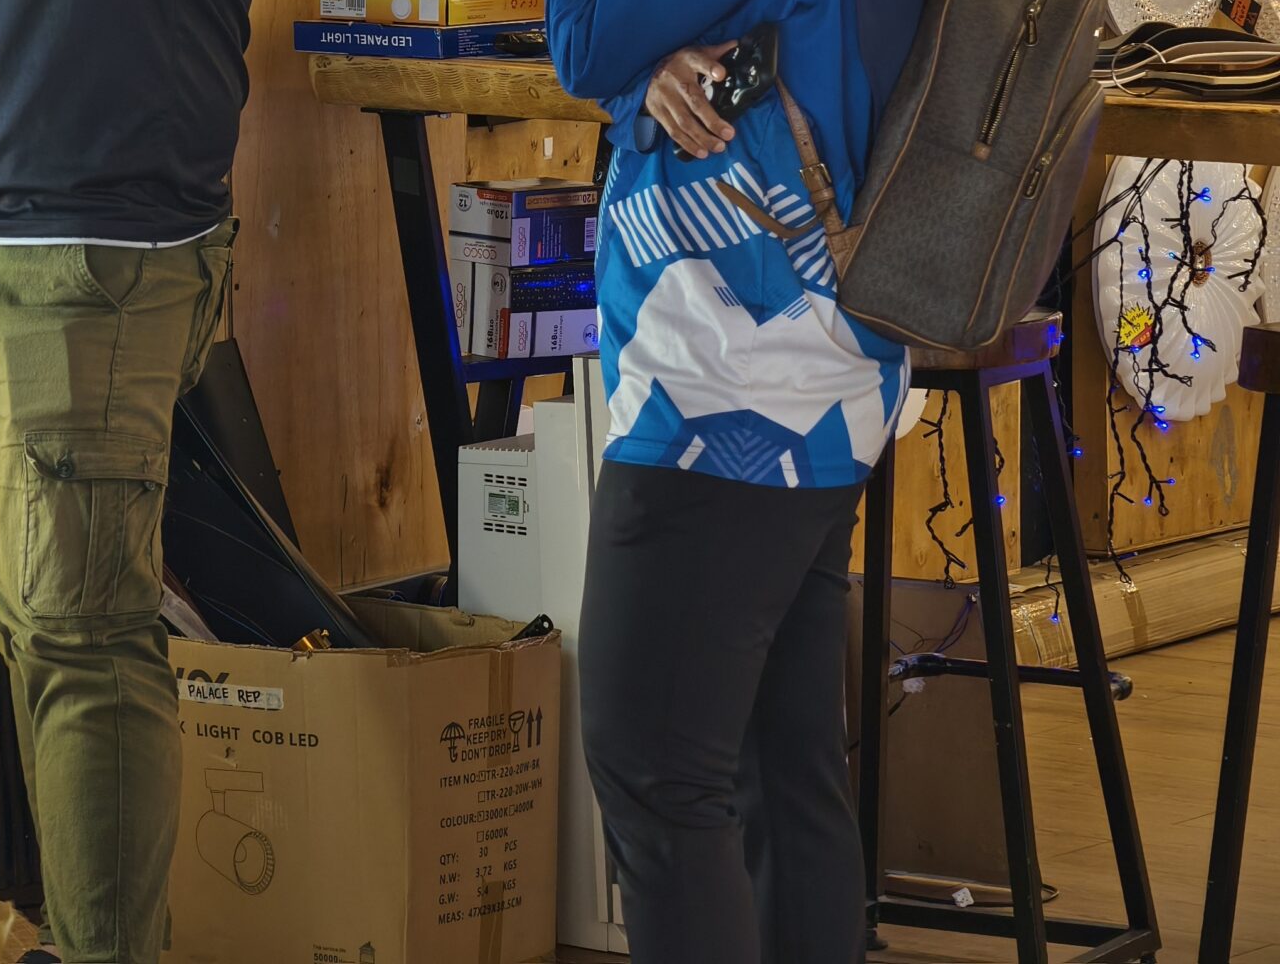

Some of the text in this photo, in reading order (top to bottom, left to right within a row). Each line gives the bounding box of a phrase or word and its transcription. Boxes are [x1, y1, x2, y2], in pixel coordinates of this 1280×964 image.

[320, 31, 412, 47] LED PANEL LIGHT
[188, 685, 262, 704] PALACE REP
[468, 714, 506, 730] FRAGILE
[196, 723, 241, 741] LIGHT
[252, 729, 285, 745] COB
[289, 732, 319, 748] LED
[466, 728, 507, 746] KEEP DRY
[461, 742, 512, 762] DON'T DROP
[440, 776, 461, 788] ITEM
[440, 800, 534, 828] COLOUR: 3000K 4000K
[485, 827, 509, 841] 6000K
[440, 840, 518, 865] QTY: 30 PCS
[440, 872, 460, 884] N.W:
[503, 859, 517, 872] KGS
[438, 892, 459, 905] G.W:
[502, 878, 516, 893] KGS
[438, 910, 464, 925] MEAS:
